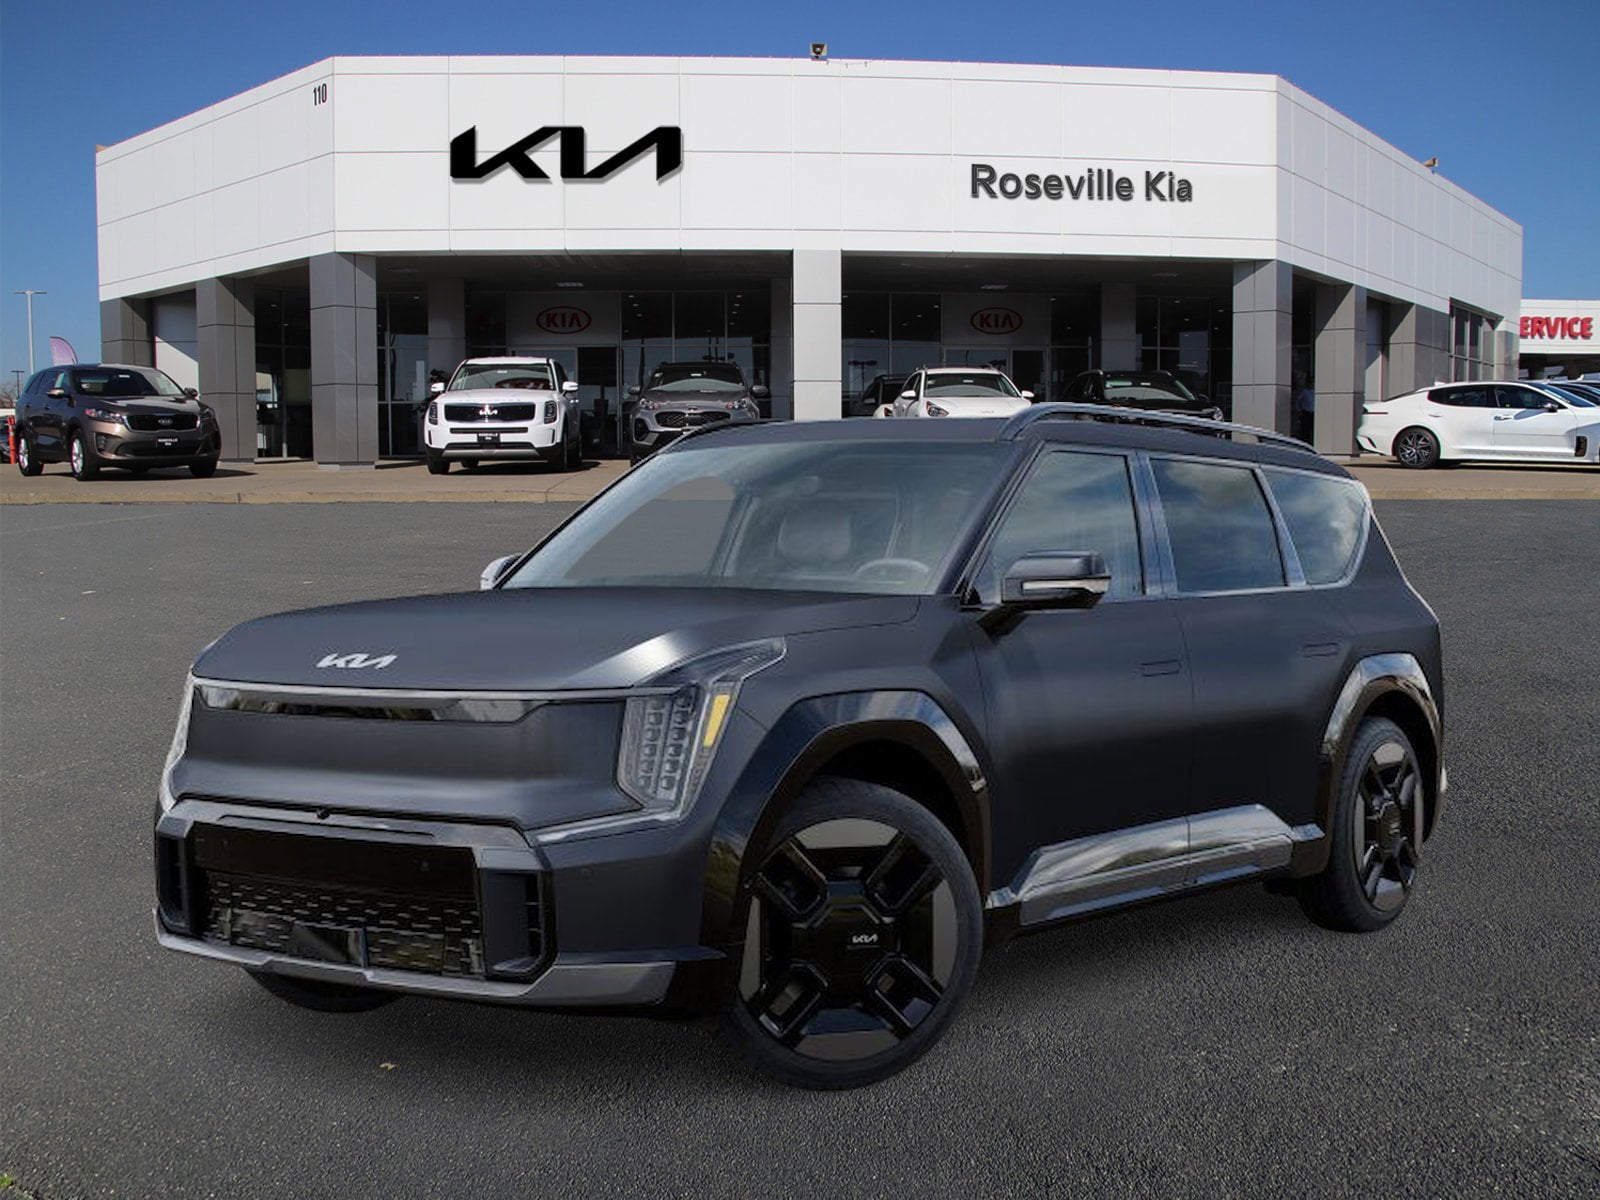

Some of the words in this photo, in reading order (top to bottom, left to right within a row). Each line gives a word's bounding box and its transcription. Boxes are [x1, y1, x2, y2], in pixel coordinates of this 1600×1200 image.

[313, 83, 327, 106] 110
[450, 125, 682, 182] KIA
[971, 164, 1135, 201] Roseville
[1145, 170, 1193, 202] Kia
[546, 312, 582, 328] KIA
[980, 312, 1014, 329] KIA
[316, 653, 398, 669] KIA
